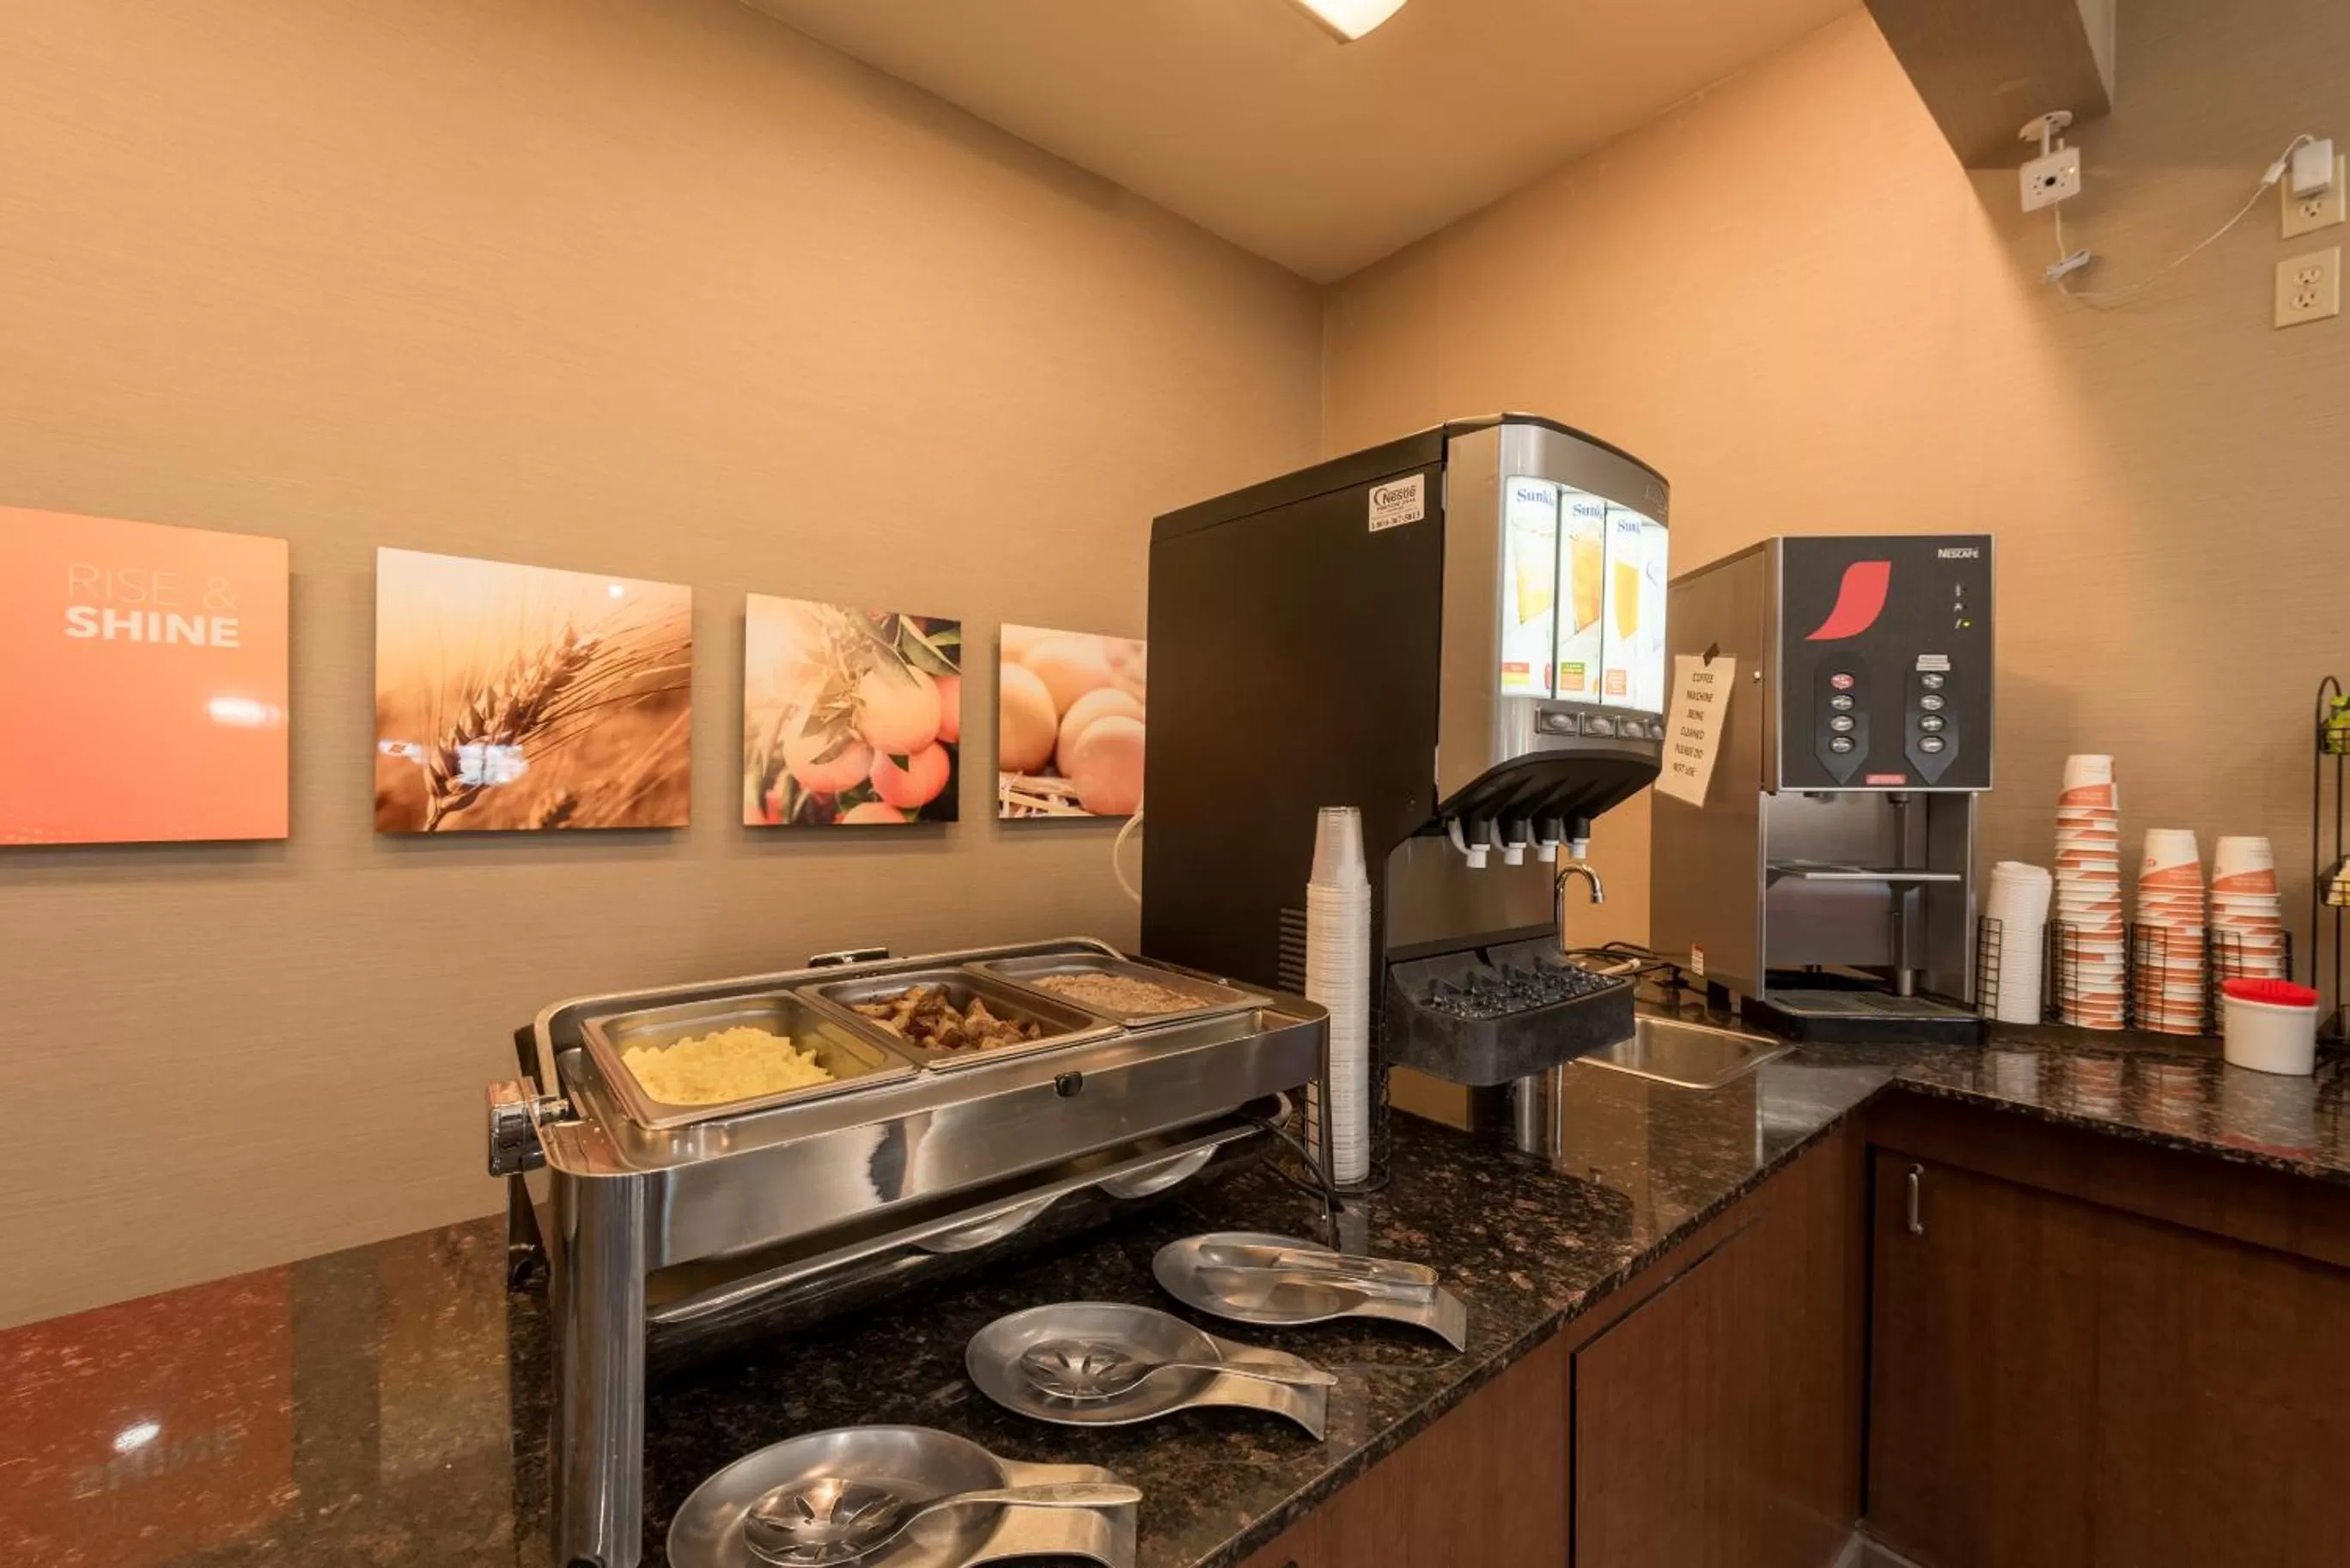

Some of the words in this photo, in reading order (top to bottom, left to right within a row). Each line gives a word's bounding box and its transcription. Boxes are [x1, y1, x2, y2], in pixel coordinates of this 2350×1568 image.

[68, 562, 180, 606] RISE
[202, 575, 238, 611] &
[64, 605, 240, 649] SHINE
[1686, 690, 1714, 702] MACHINE
